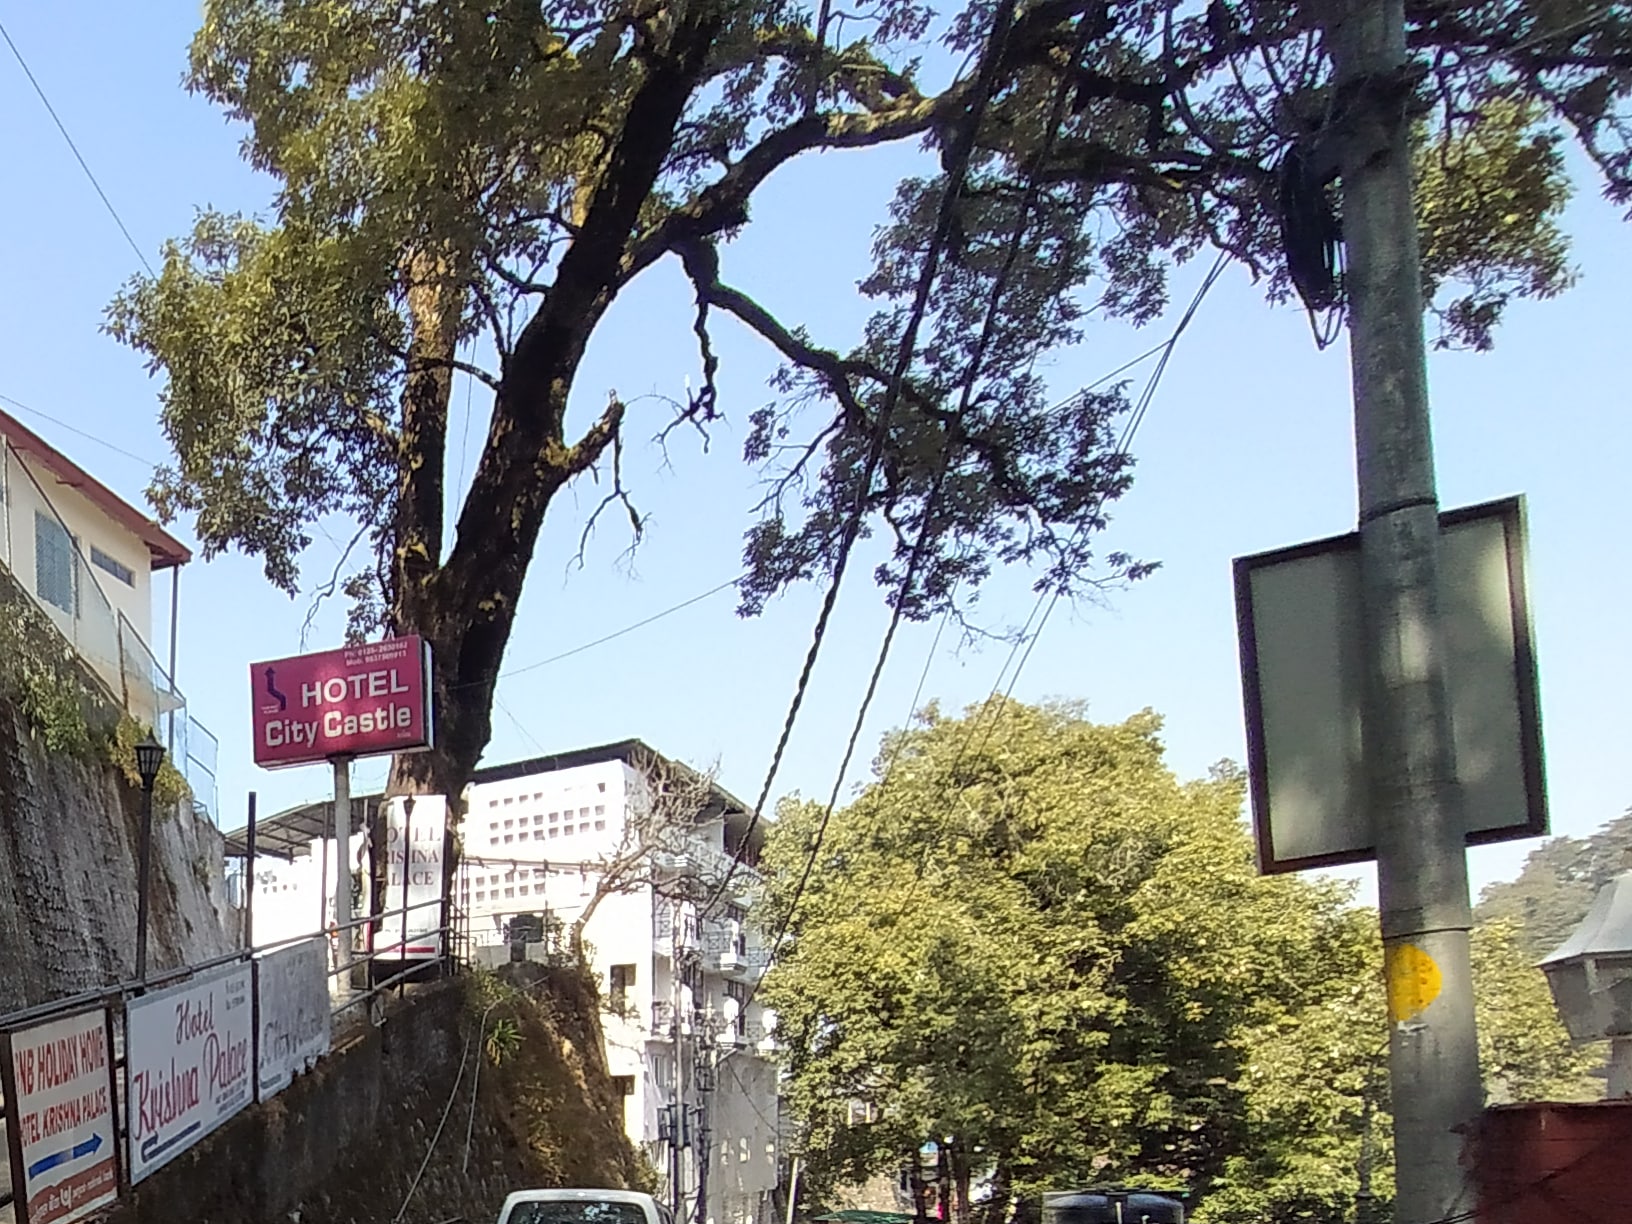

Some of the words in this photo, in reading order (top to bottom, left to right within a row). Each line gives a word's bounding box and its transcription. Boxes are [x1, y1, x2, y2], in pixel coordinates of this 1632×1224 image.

[302, 669, 409, 707] HOTEL
[265, 718, 318, 748] City
[323, 702, 411, 738] Castle
[387, 826, 441, 844] OEL
[176, 991, 215, 1045] Hotel
[37, 1034, 79, 1092] HOLIDAY
[79, 1025, 105, 1075] HOME
[131, 1056, 199, 1141] Krishna
[202, 1032, 248, 1101] Palace
[20, 1111, 41, 1147] OTEL
[43, 1098, 82, 1138] KRISHNA
[82, 1085, 108, 1123] PALACE
